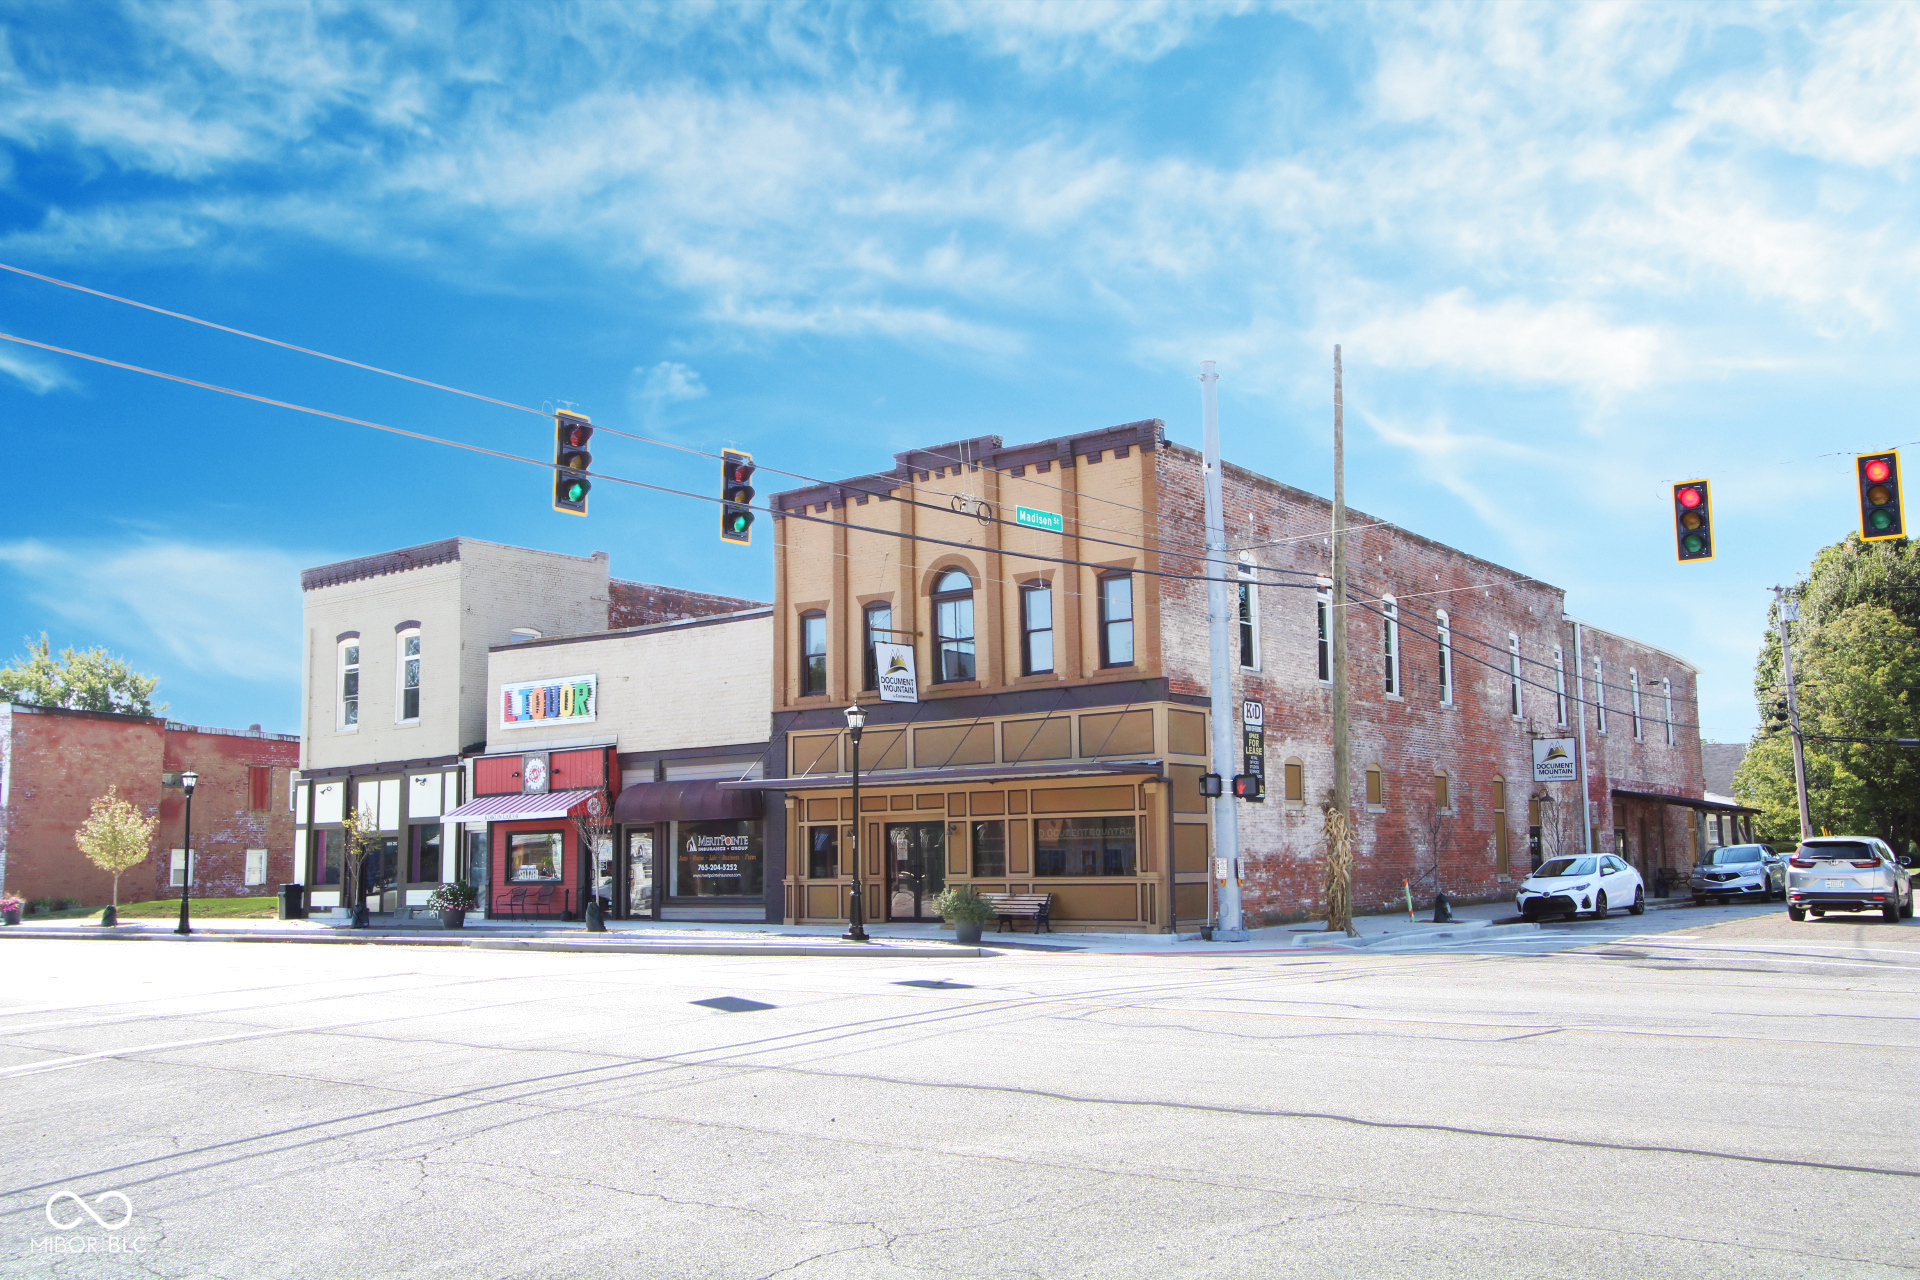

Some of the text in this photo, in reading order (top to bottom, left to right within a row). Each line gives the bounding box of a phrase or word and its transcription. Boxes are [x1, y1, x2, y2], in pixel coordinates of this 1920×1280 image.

[1020, 510, 1060, 526] Madison St
[880, 676, 914, 686] DOCUMENT
[884, 684, 914, 694] MOUNTAIN
[504, 682, 589, 722] LIQUOR
[1249, 739, 1259, 747] FOR
[1246, 746, 1262, 755] LEASE
